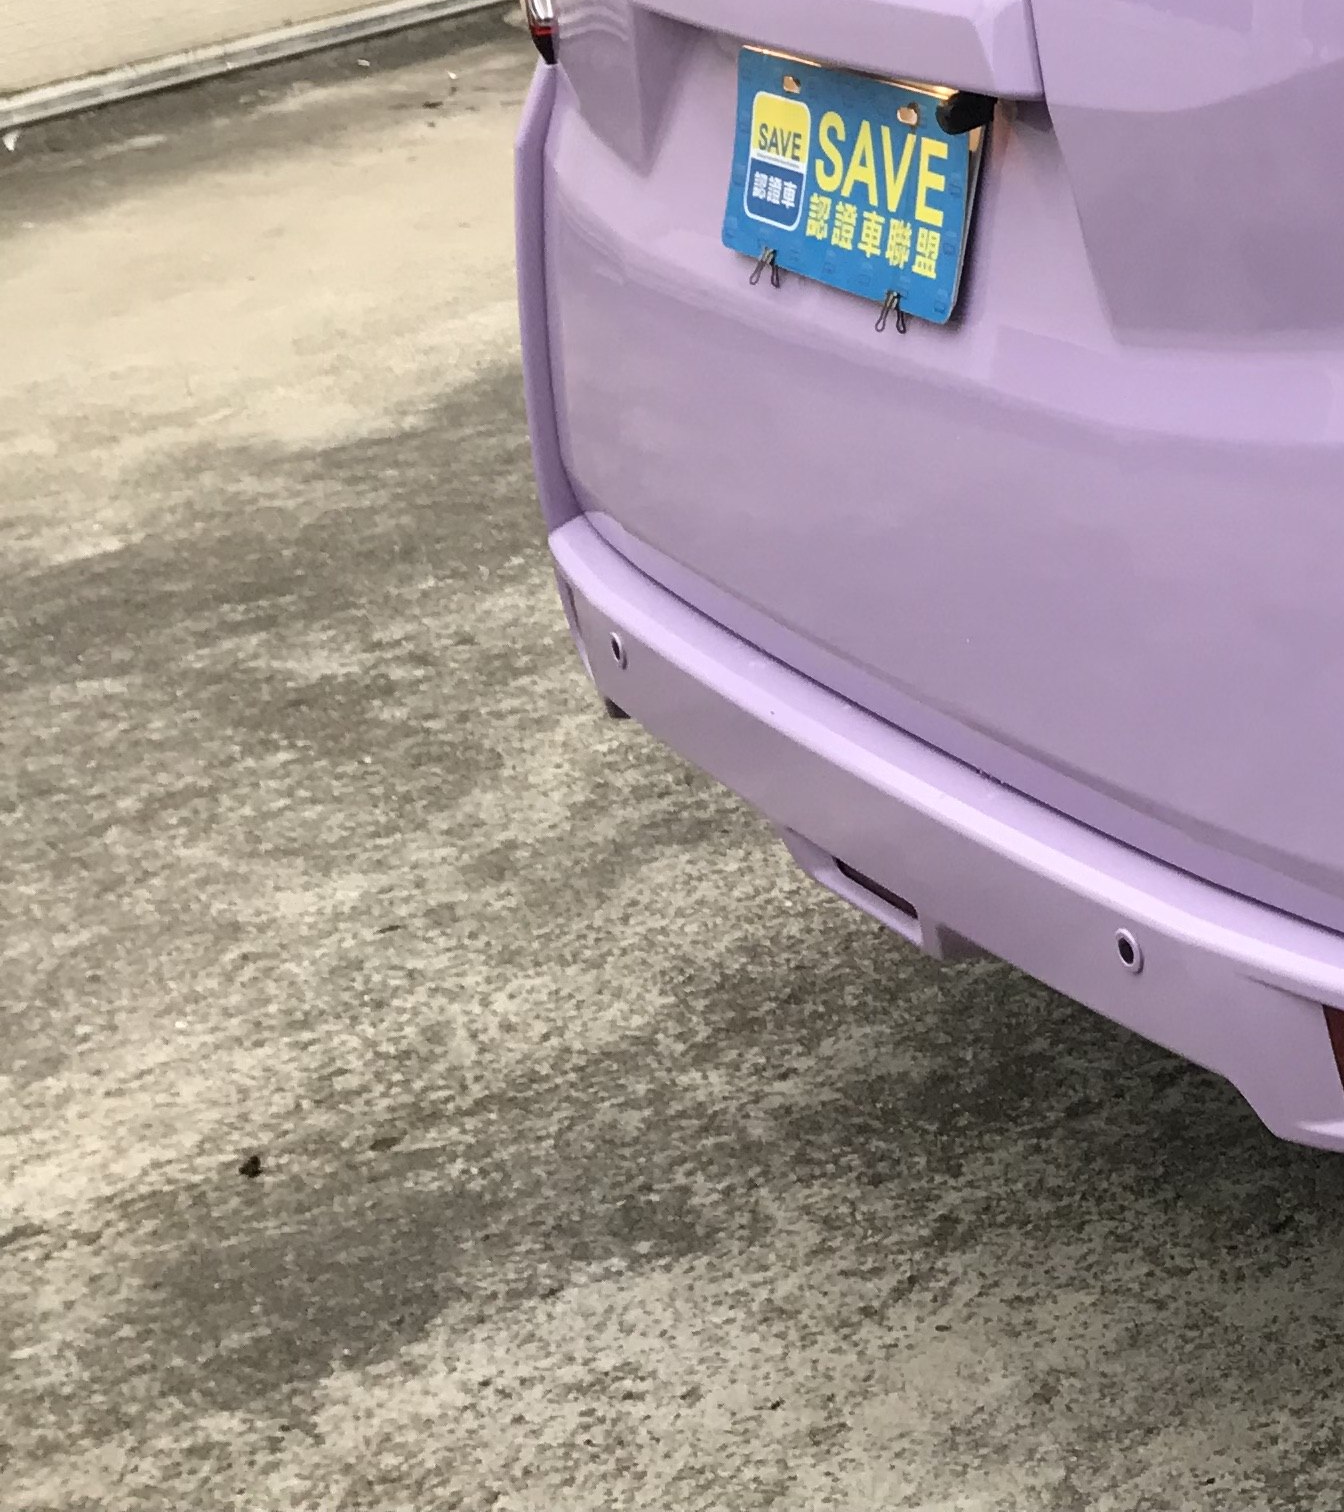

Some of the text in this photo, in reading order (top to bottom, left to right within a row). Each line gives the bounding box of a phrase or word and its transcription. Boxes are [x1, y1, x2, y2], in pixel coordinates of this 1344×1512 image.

[758, 123, 802, 161] SAVE
[815, 111, 948, 227] SAVE
[805, 193, 941, 279] 認證車聯盟
